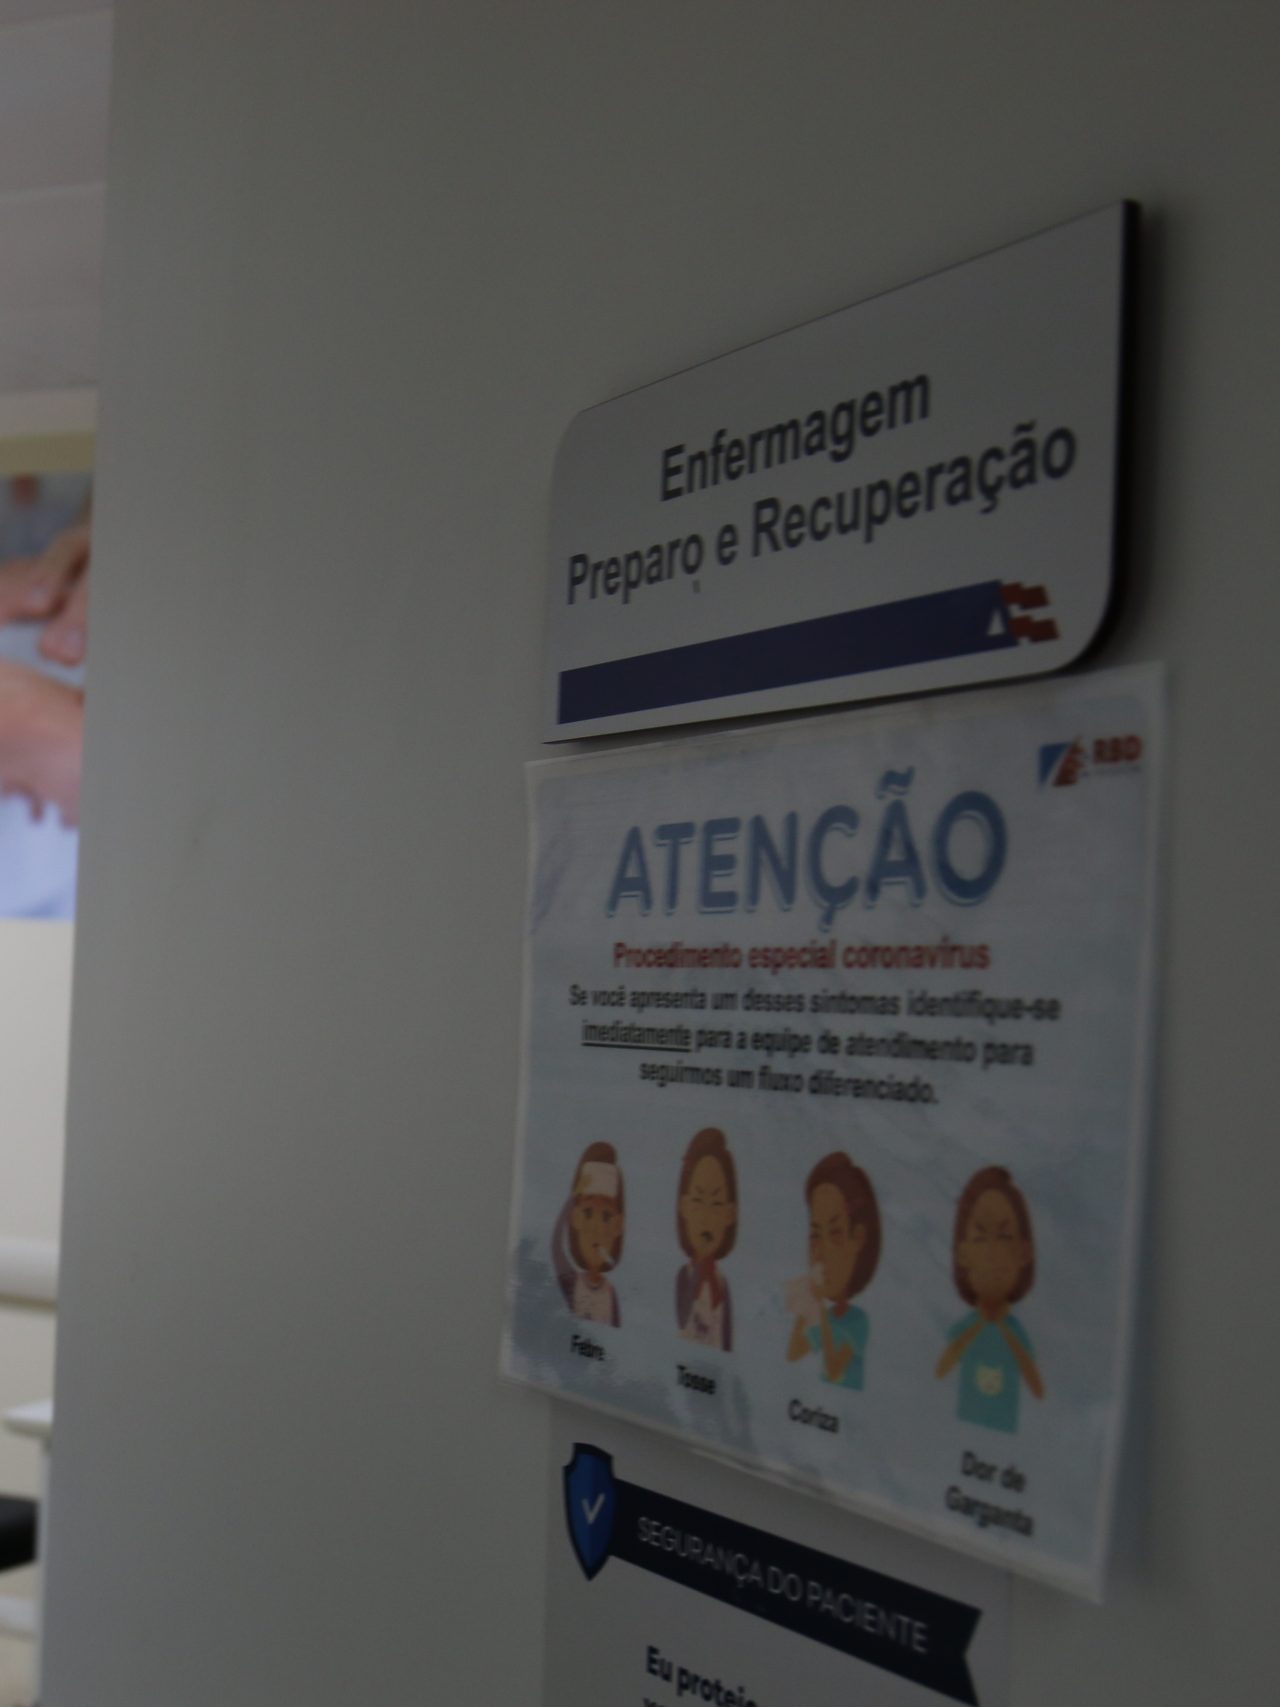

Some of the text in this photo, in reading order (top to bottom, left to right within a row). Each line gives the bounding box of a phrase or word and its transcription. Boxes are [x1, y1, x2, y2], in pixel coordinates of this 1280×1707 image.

[660, 374, 931, 501] Enfermagem
[566, 420, 1078, 605] Preparo e Recuperação
[605, 766, 1007, 933] ATENÇÃO
[613, 941, 742, 970] Procedimento
[748, 939, 837, 975] especial
[570, 984, 1061, 1026] Se você apresenta um desses sintomas identifique-se
[582, 1019, 1033, 1071] imediatamente para a equipe de atendimento para
[639, 1059, 940, 1104] seguirmos um fluxo diferenciado.
[570, 1333, 606, 1362] Febre
[676, 1363, 716, 1396] Tosse
[787, 1398, 840, 1434] Coriza
[961, 1450, 1027, 1494] Dor de
[944, 1484, 1035, 1538] Garganta
[637, 1515, 929, 1655] SEGURANÇA DO PACIENTE
[646, 1645, 758, 1707] Eu prote
